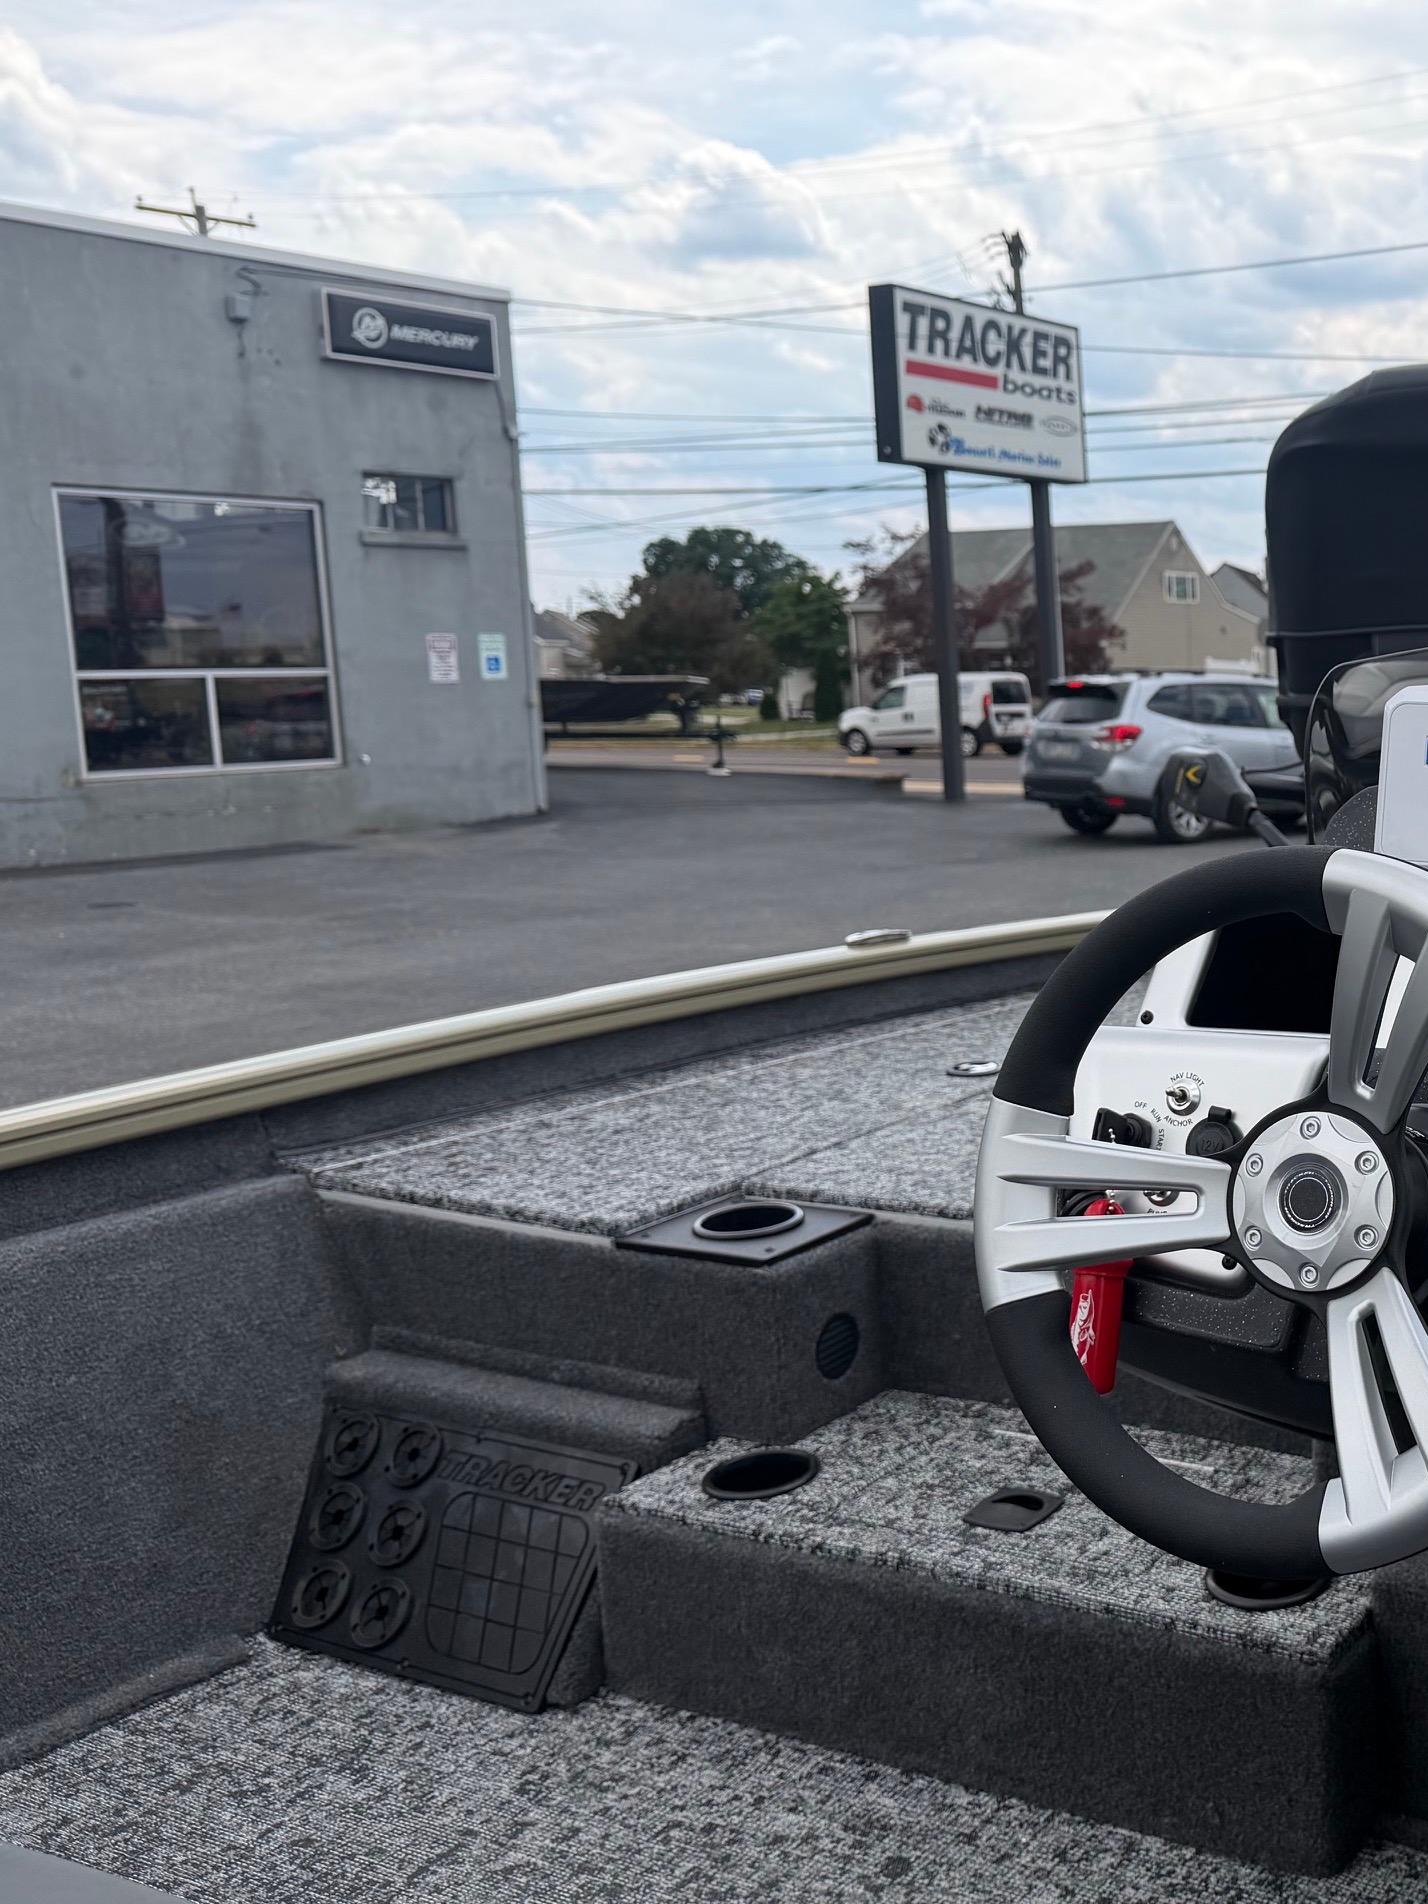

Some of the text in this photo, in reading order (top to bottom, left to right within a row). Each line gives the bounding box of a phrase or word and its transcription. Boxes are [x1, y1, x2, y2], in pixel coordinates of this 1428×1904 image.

[389, 324, 479, 351] MERCURY
[902, 301, 1075, 382] TRACKER
[1002, 373, 1077, 405] boats
[1170, 1072, 1205, 1086] NAV LIGHT
[1134, 1101, 1147, 1109] OFF
[1151, 1108, 1162, 1122] RUN
[1164, 1115, 1193, 1127] ANCHOR
[437, 1449, 607, 1512] TRACKER
